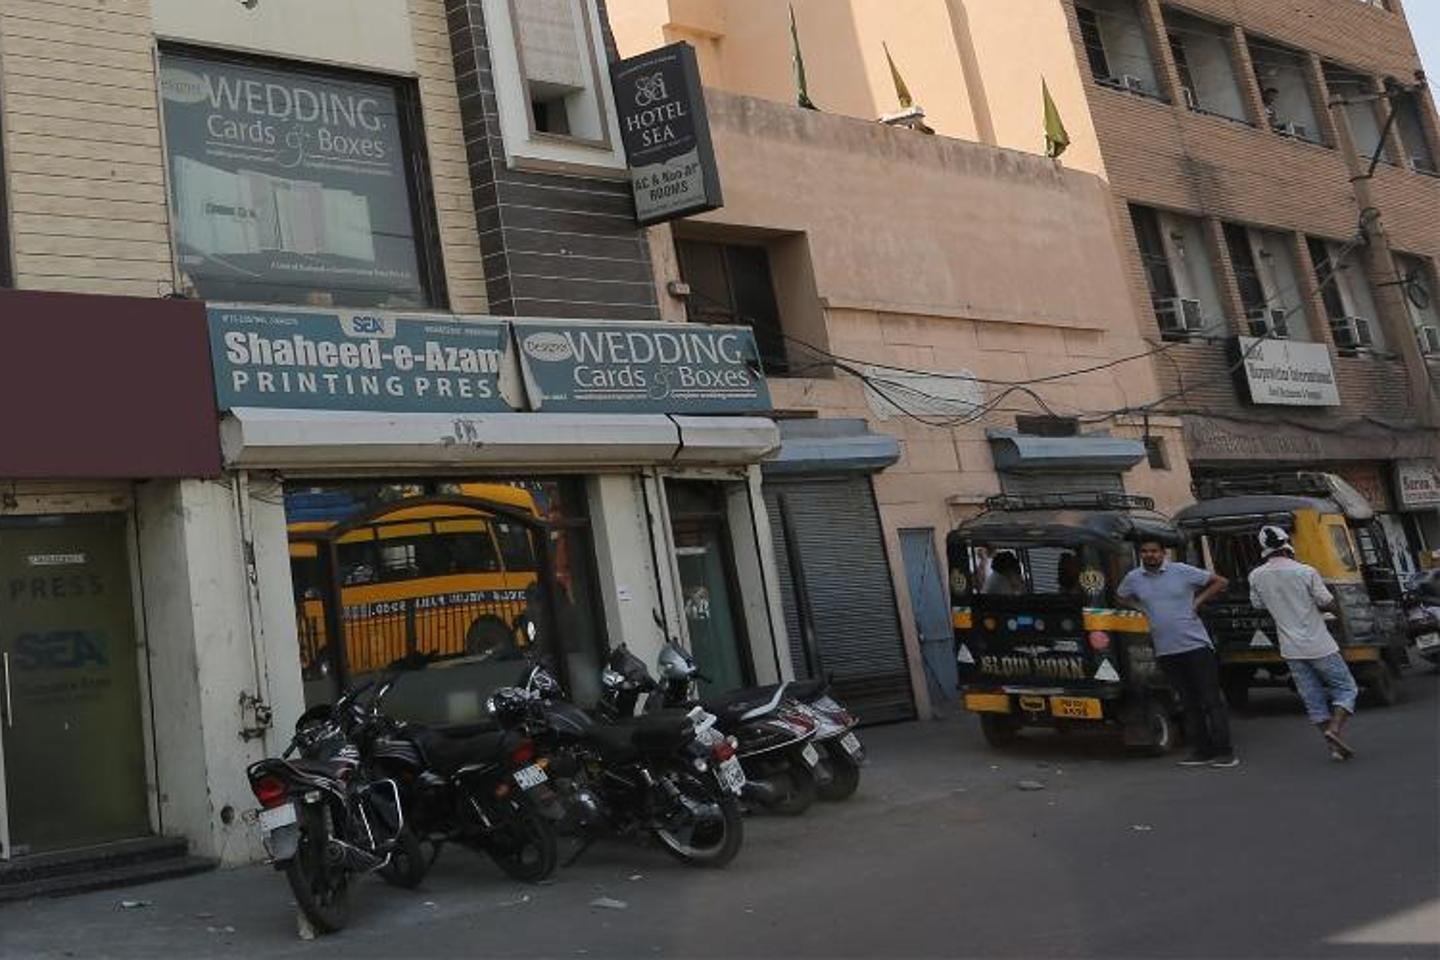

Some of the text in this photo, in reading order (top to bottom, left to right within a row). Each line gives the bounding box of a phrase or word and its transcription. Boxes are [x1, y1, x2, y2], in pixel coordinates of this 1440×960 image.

[204, 74, 383, 131] WEDDING
[626, 100, 687, 132] HOTEL
[207, 114, 276, 145] Cards
[318, 128, 385, 159] Boxes
[642, 125, 675, 147] SEA
[353, 316, 384, 334] SEA
[224, 331, 502, 374] Shaheed-e-Azam
[564, 330, 742, 364] WEDDING
[232, 370, 493, 399] PRINTING PRES
[574, 366, 647, 388] Cards
[679, 366, 750, 387] Boxes
